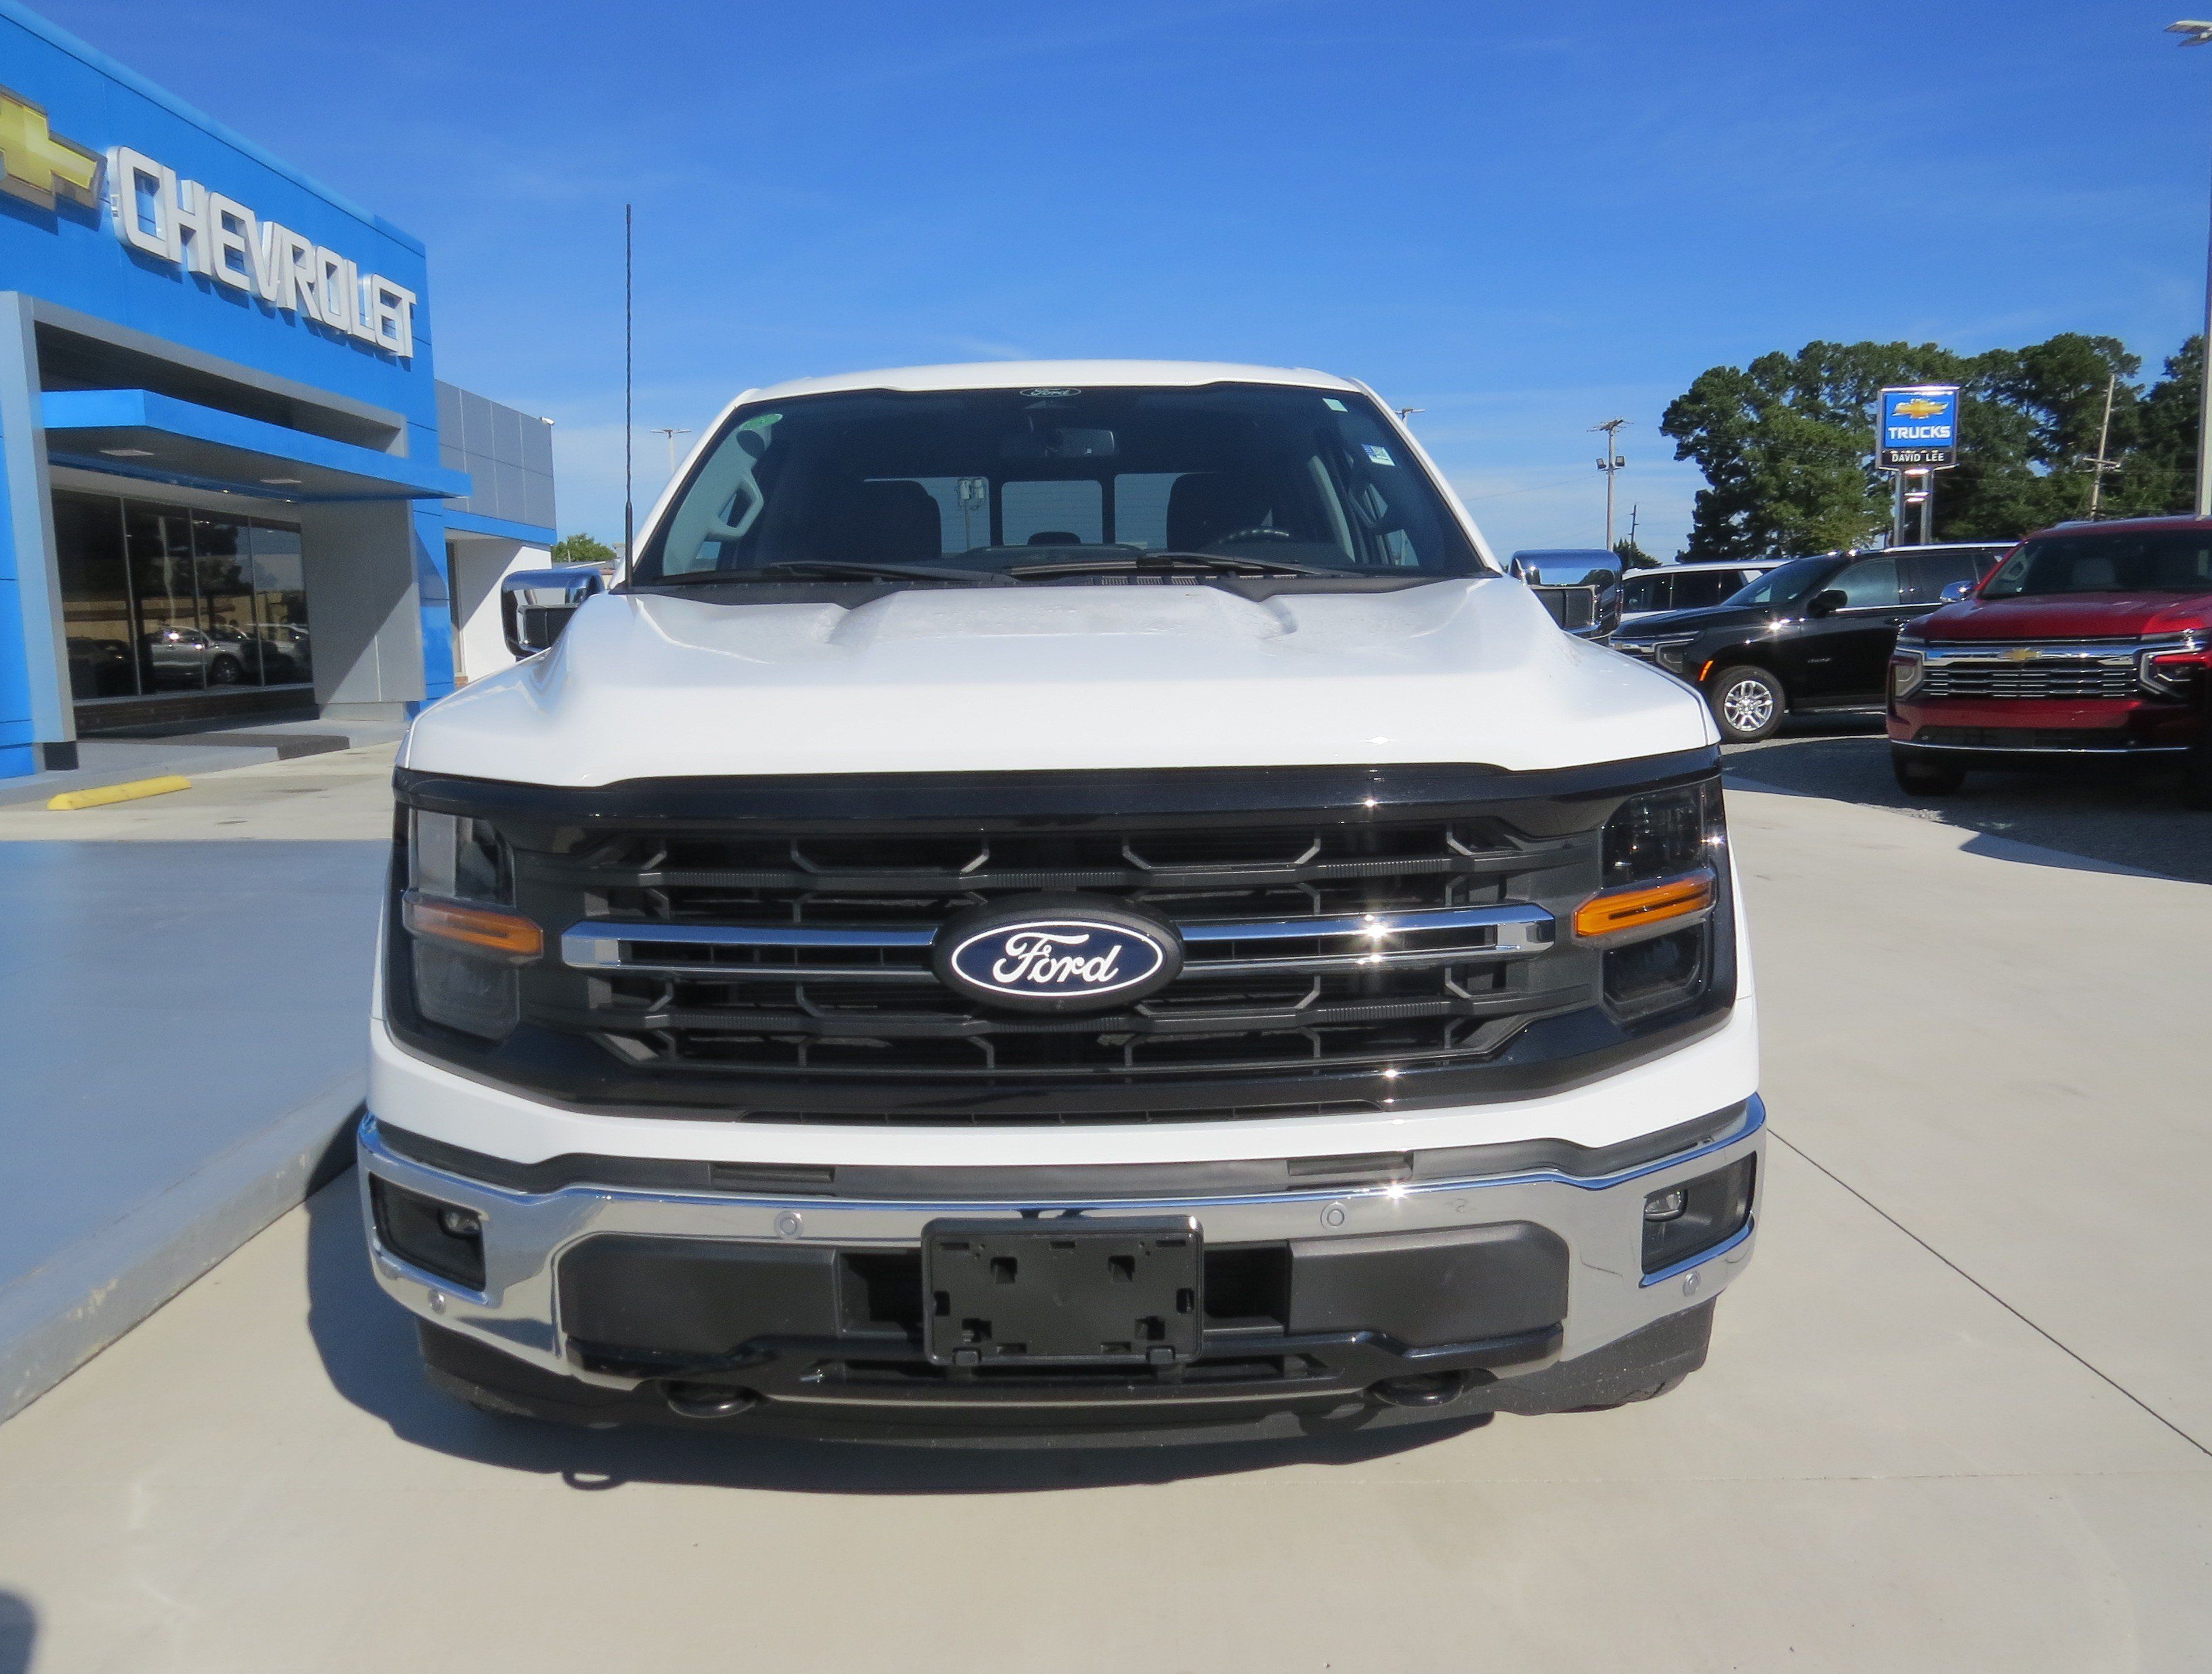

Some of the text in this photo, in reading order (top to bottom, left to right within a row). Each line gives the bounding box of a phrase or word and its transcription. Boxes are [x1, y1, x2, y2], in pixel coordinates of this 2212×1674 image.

[106, 145, 417, 358] CHEVROLET
[1888, 425, 1951, 439] TRUCKS
[1891, 452, 1944, 462] DAVID LEE
[992, 932, 1122, 983] Ford
